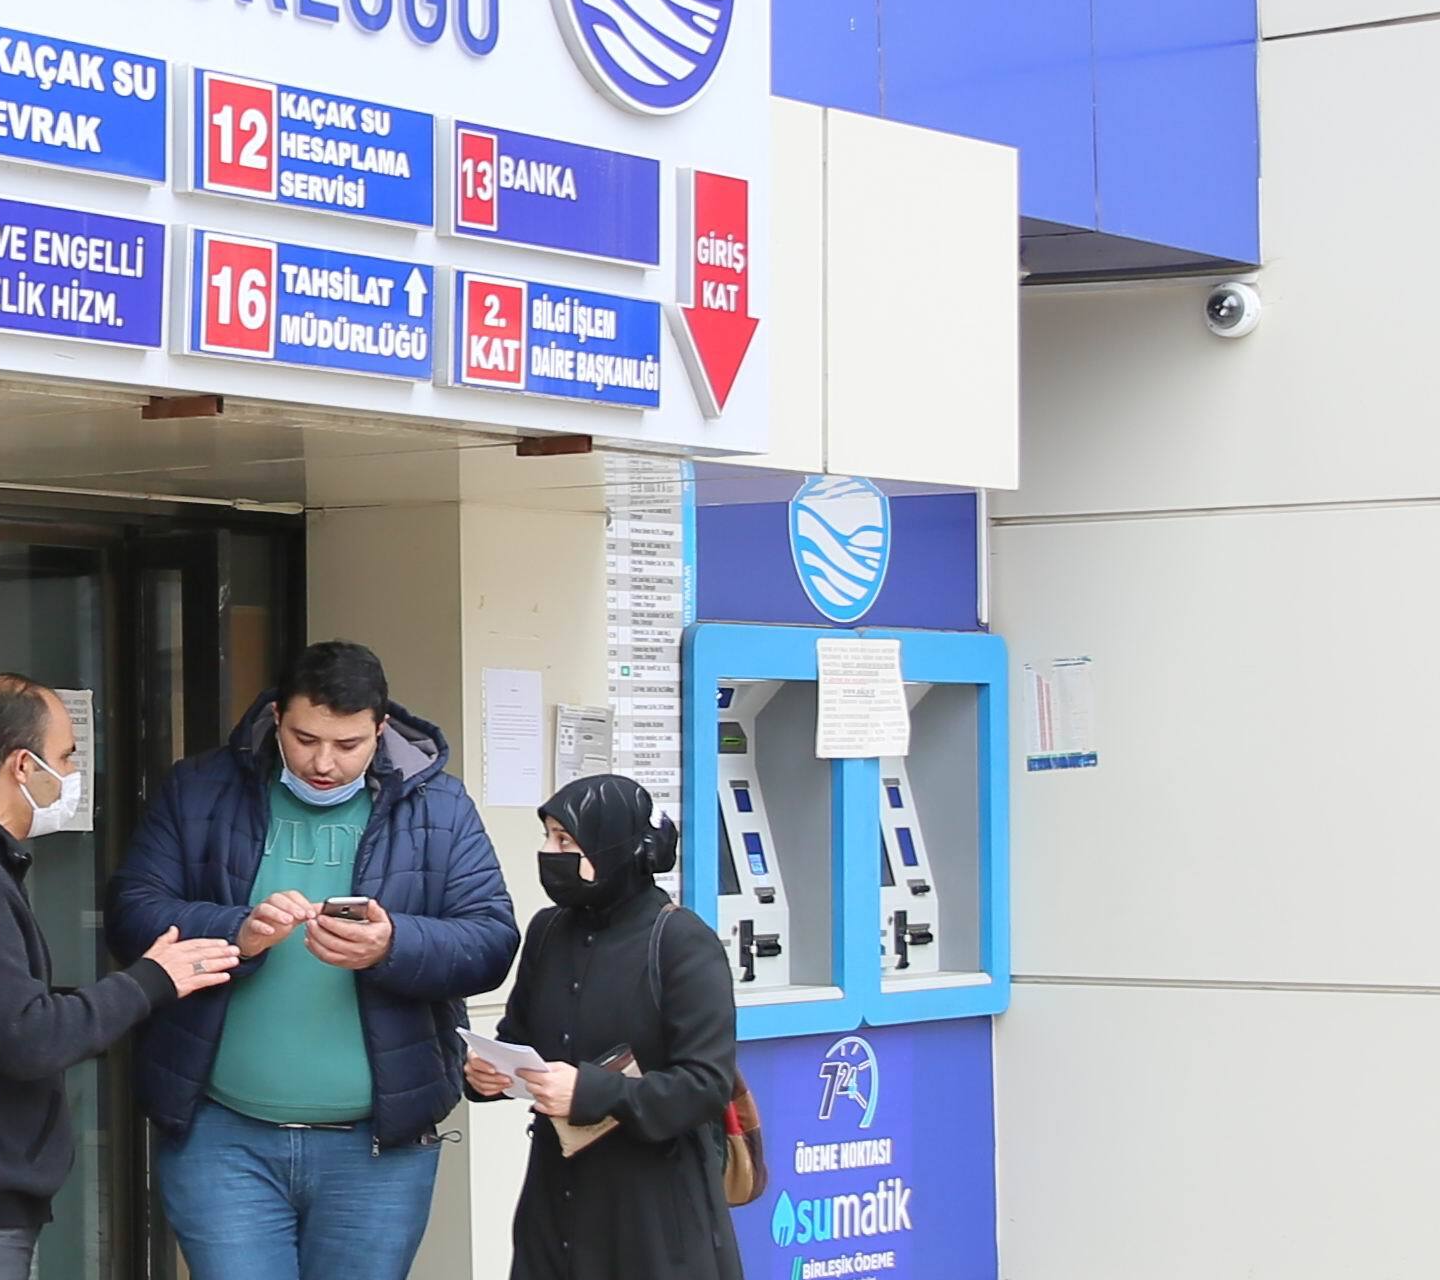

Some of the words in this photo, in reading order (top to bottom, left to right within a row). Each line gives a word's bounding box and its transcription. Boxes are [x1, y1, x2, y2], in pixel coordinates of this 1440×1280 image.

[111, 59, 157, 101] SU
[212, 104, 269, 169] 12
[280, 92, 356, 131] KAÇAK
[360, 108, 390, 137] SU
[280, 135, 411, 179] HESAPLAMA
[461, 157, 494, 202] 13
[499, 154, 577, 201] BANKA
[280, 170, 365, 209] SERVİSİ
[32, 225, 144, 279] ENGELLİ
[697, 229, 745, 273] GİRİŞ
[51, 277, 124, 327] HİZM.
[210, 265, 269, 330] 16
[281, 263, 395, 308] TAHSİLAT
[703, 282, 739, 312] KAT
[483, 293, 508, 328] 2.
[531, 292, 570, 332] BİLGİ
[574, 297, 617, 343] İŞLEM
[280, 313, 428, 361] MÜDÜRLÜĞÜ
[469, 335, 520, 372] KAT
[531, 345, 574, 380] DAİRE
[576, 350, 660, 392] BAŞKANLIĞI
[795, 1141, 839, 1174] ÖDEME
[840, 1138, 892, 1169] NOKTASI
[796, 1177, 912, 1245] sumatik
[802, 1254, 855, 1280] BİRLEŞİK
[855, 1251, 895, 1272] ÖDEME
